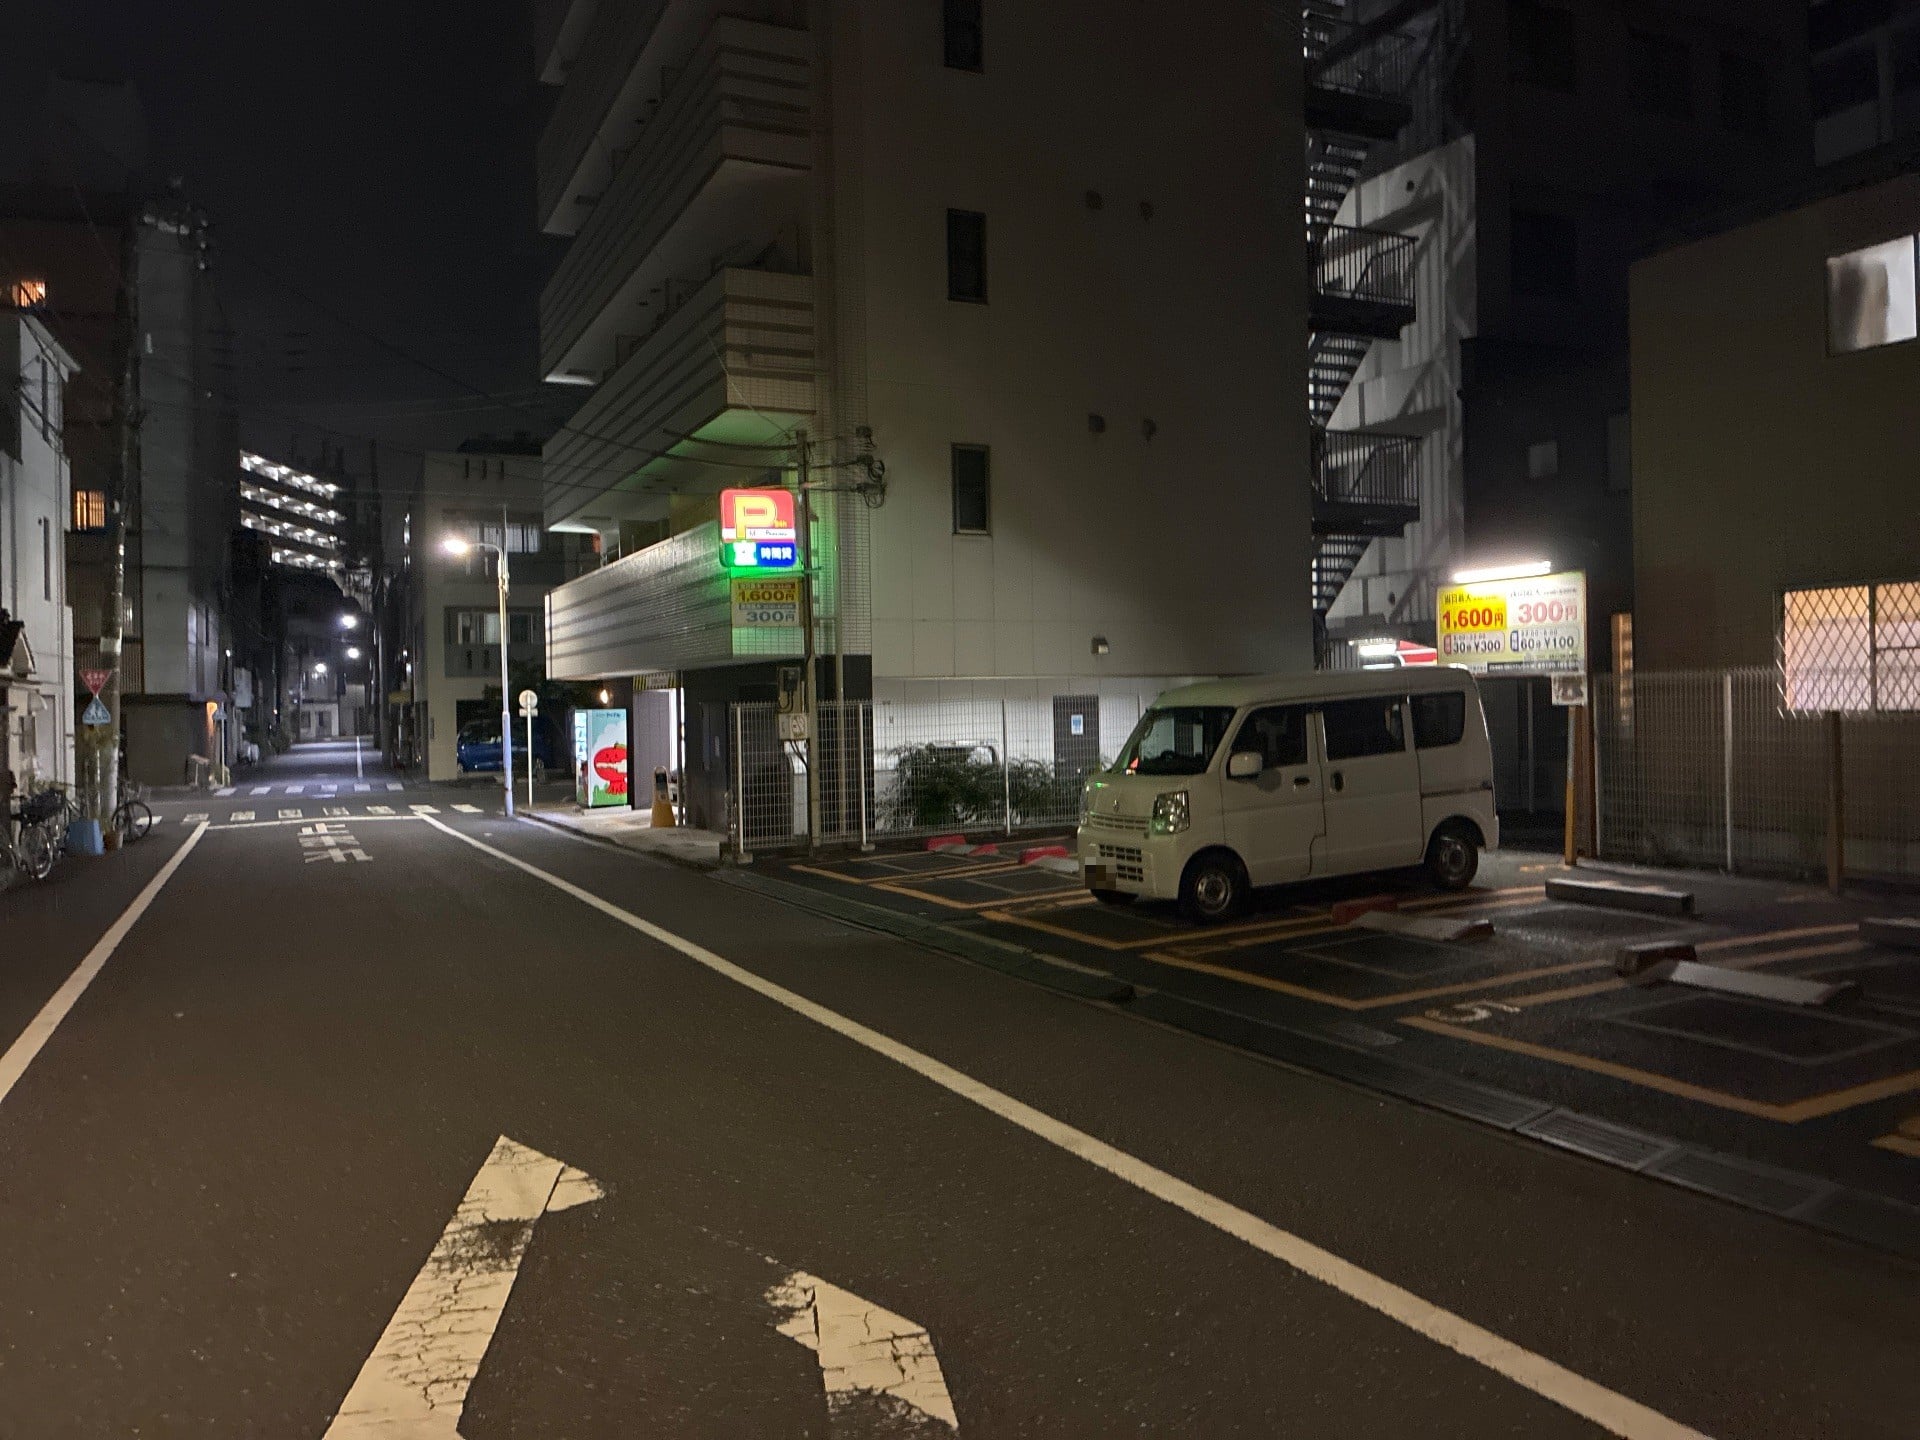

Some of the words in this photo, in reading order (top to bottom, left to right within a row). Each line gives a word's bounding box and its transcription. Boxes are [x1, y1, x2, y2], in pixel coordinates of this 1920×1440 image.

[733, 495, 777, 540] P
[746, 611, 795, 622] 300円
[1442, 608, 1504, 629] 1,600円
[1518, 600, 1577, 623] 300円
[297, 823, 374, 863] 止まれ
